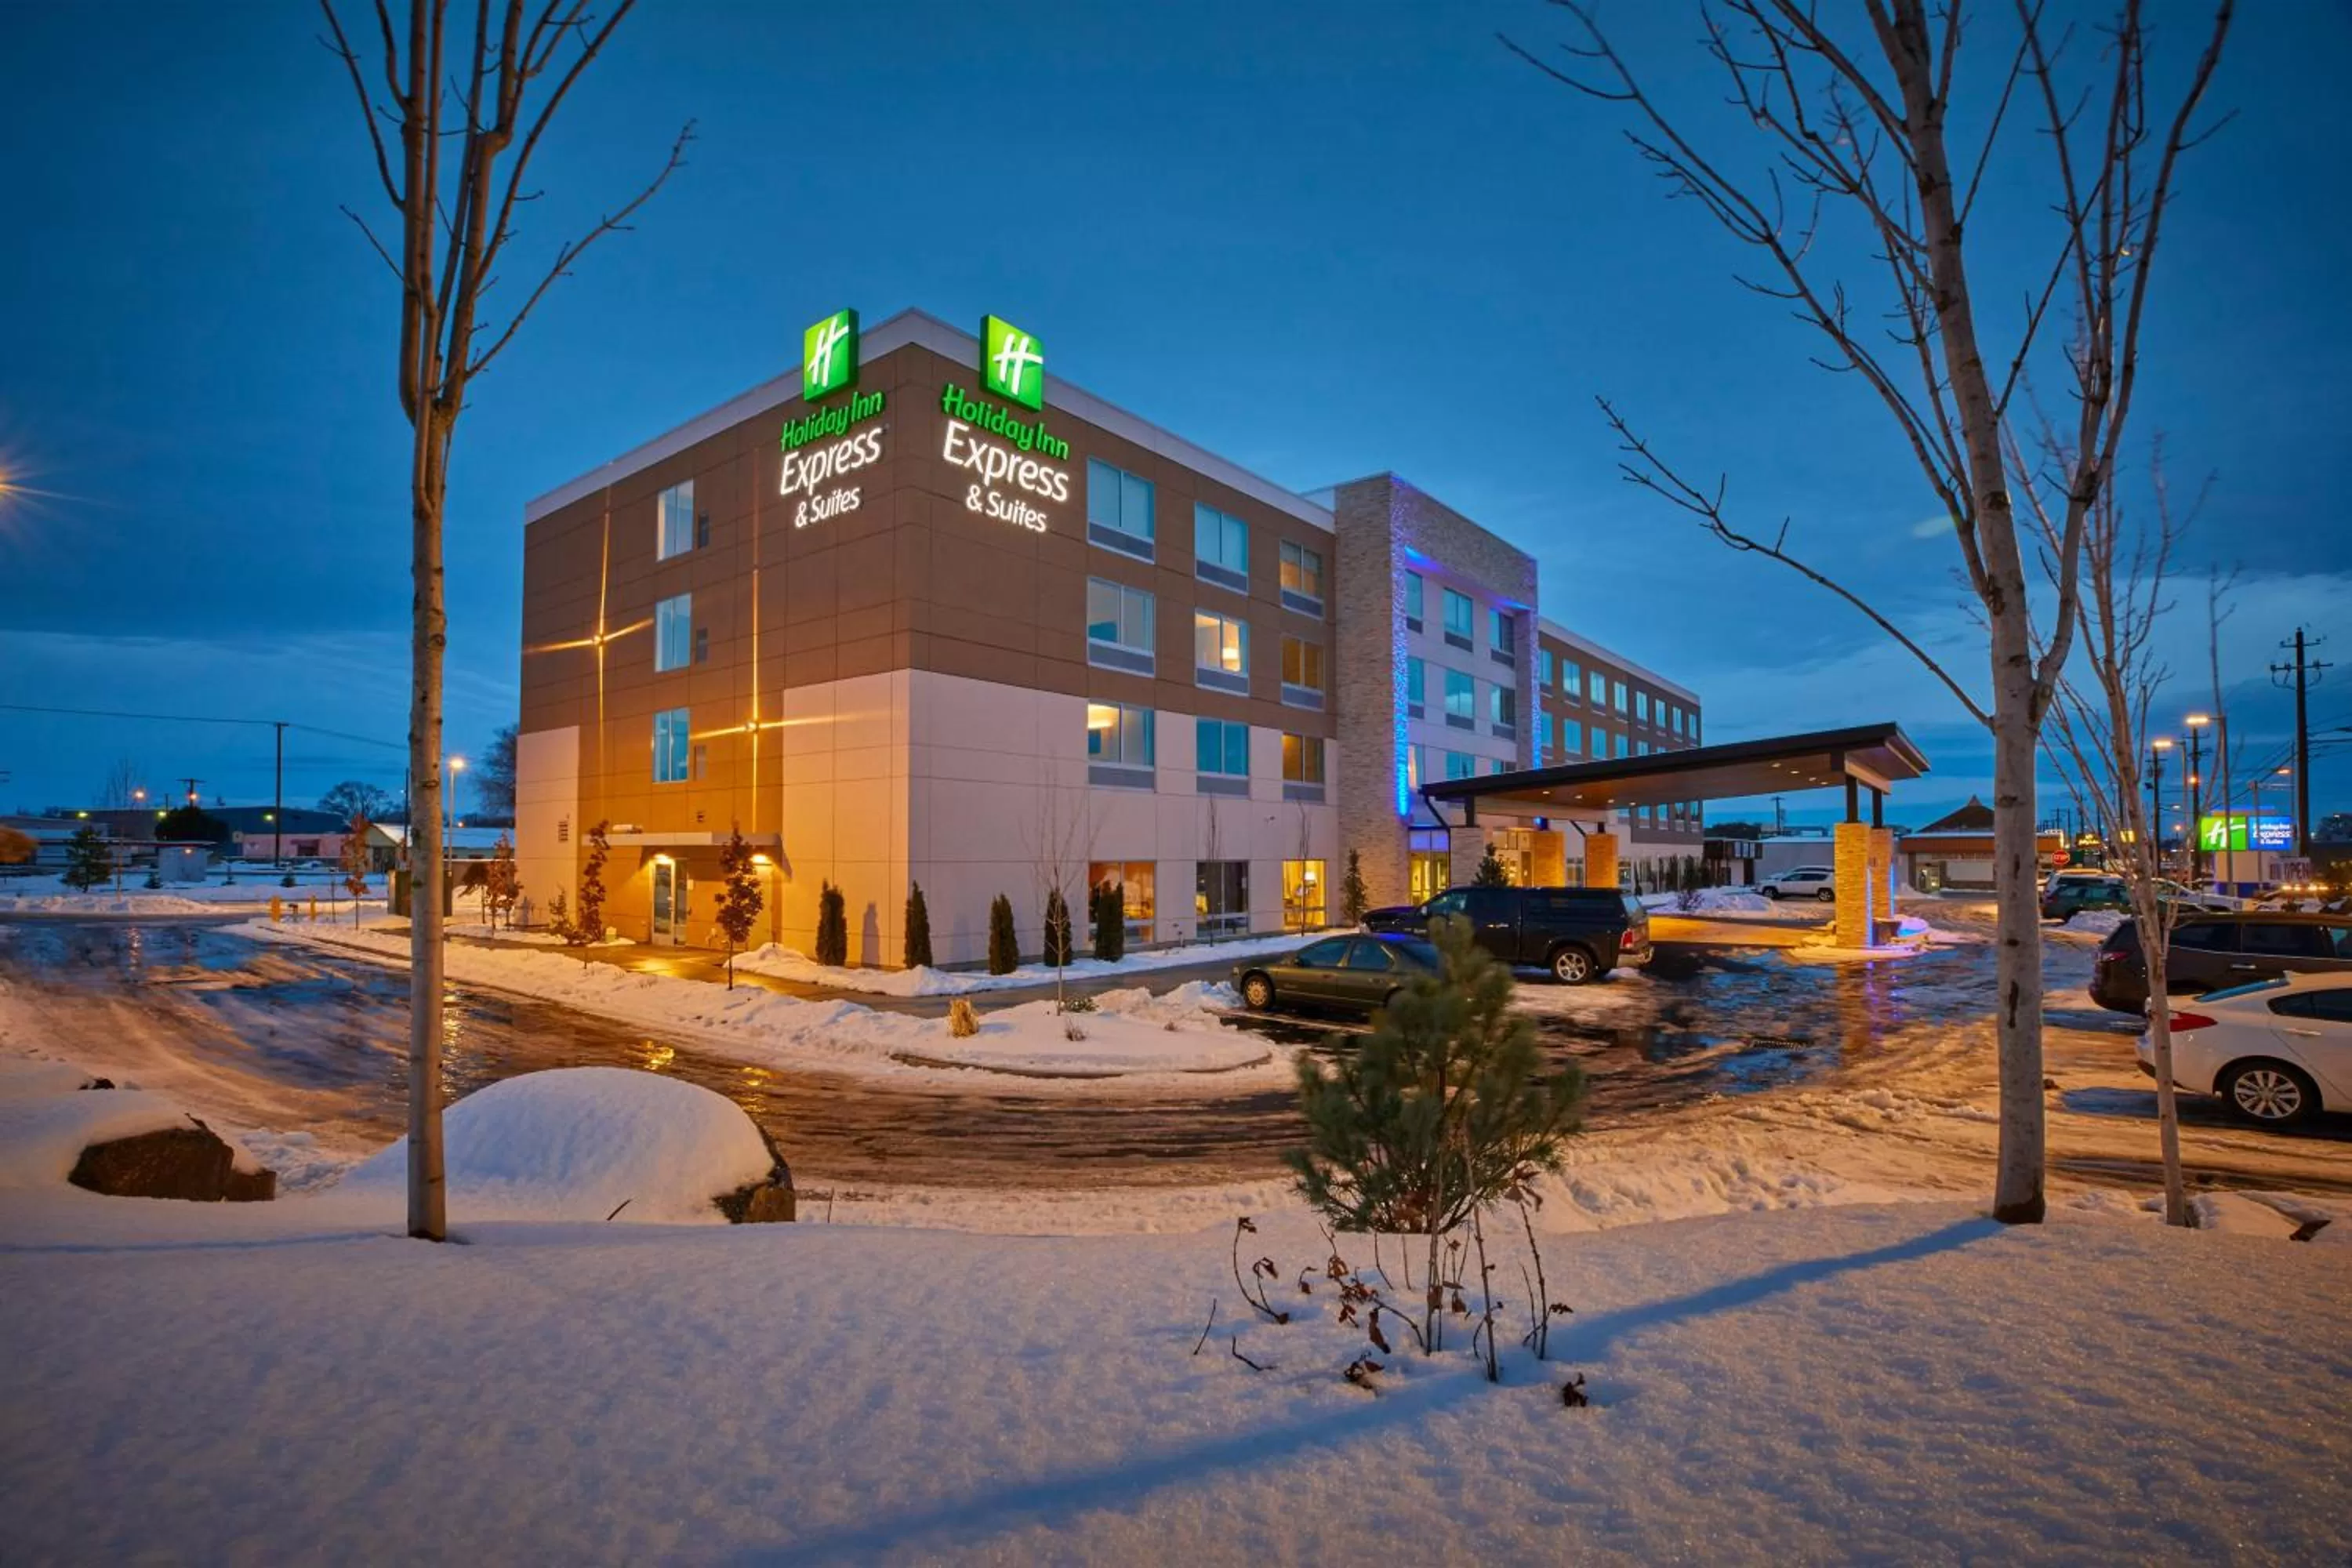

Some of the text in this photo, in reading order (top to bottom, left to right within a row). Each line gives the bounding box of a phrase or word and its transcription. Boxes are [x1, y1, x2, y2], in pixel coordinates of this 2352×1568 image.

[780, 391, 882, 452] Holiday Inn
[942, 383, 1069, 460] Holiday Inn
[780, 426, 883, 496] Express
[942, 419, 1069, 503] Express
[795, 487, 861, 528] & Suites
[965, 485, 1047, 533] & Suites
